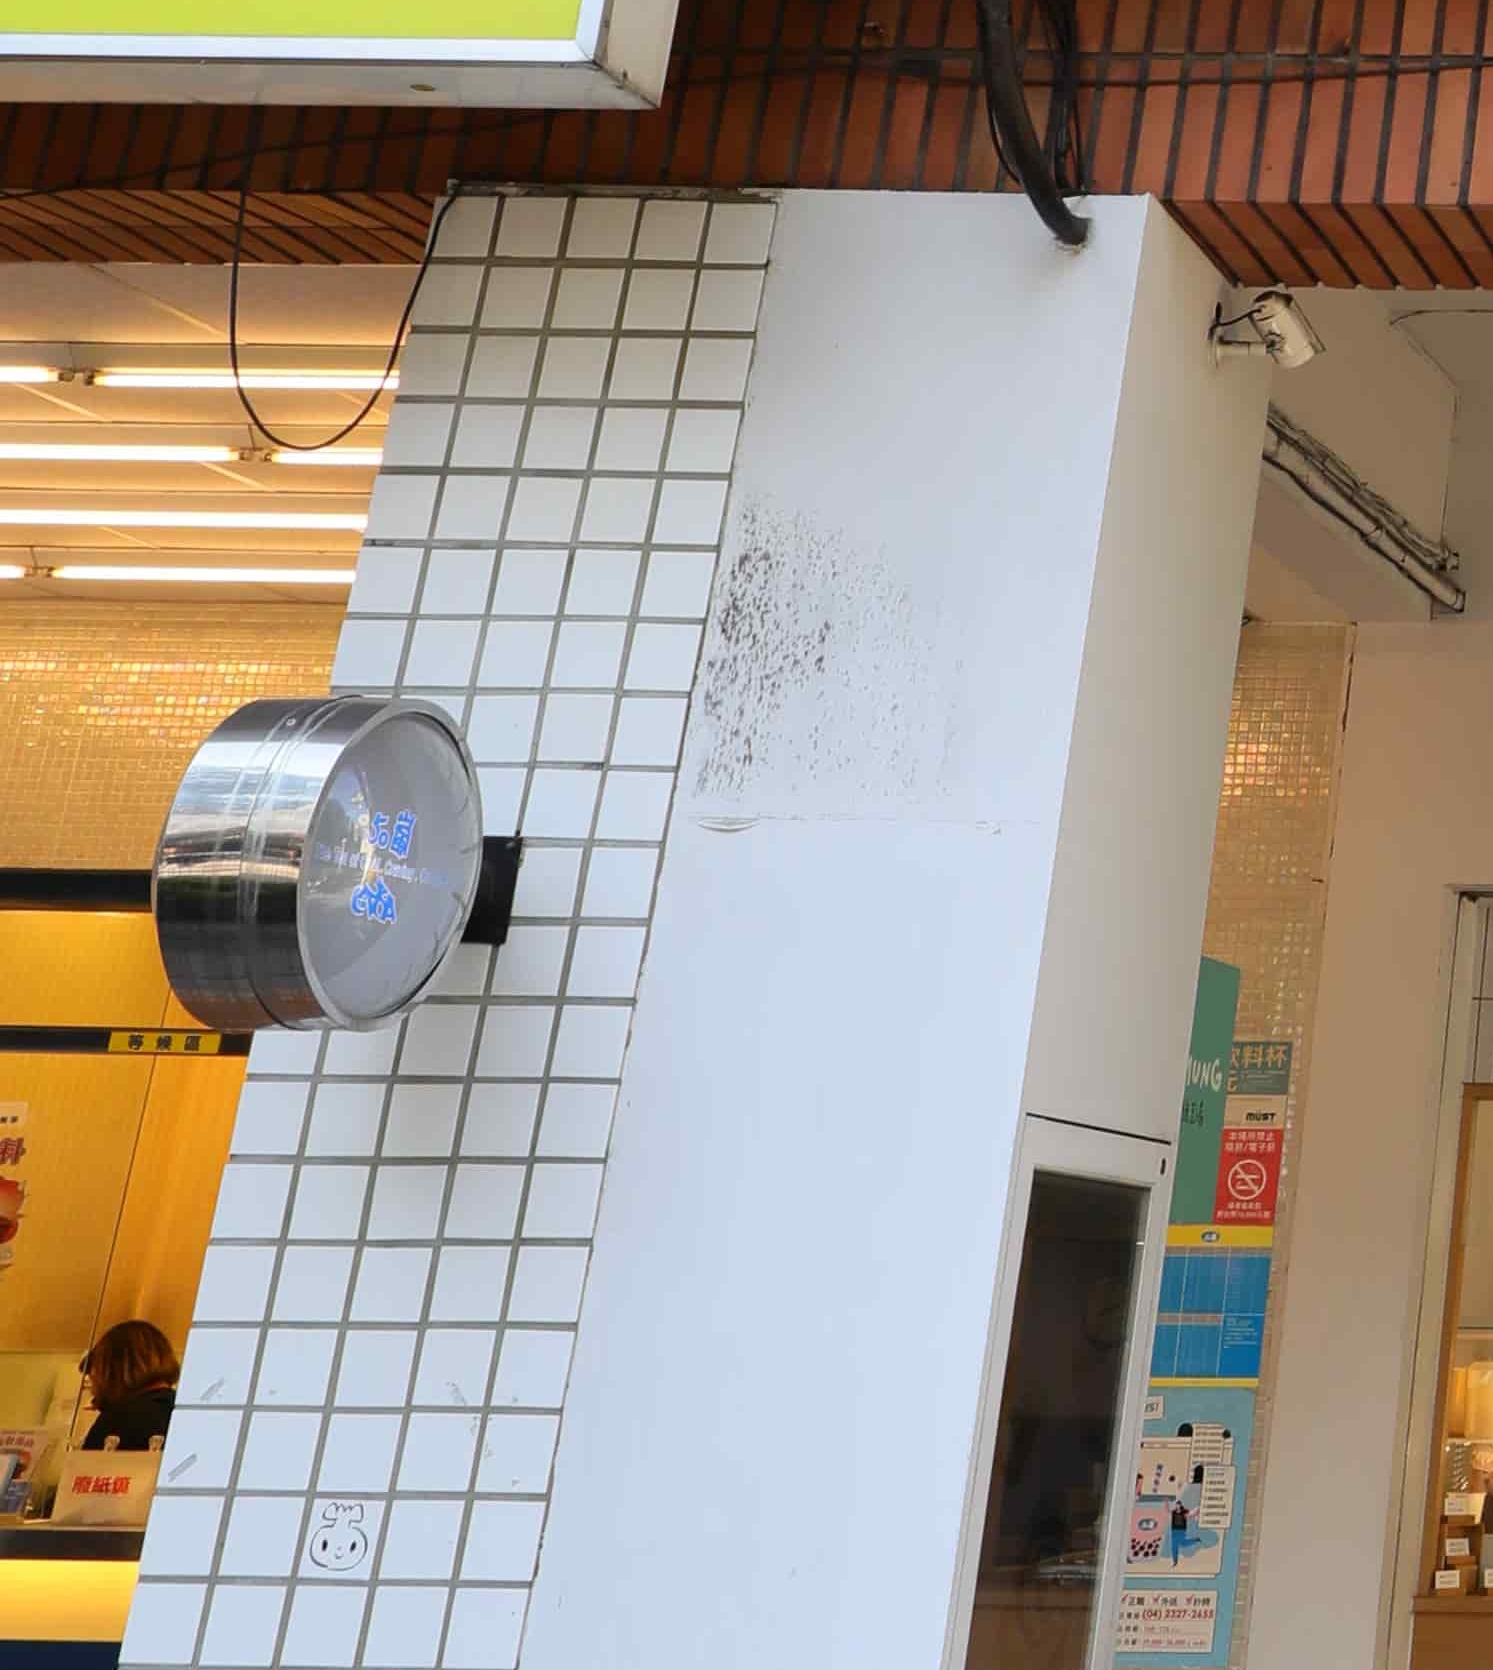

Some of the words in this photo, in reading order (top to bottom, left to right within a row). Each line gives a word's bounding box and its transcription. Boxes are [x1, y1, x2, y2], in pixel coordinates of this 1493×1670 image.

[127, 1034, 203, 1051] 等候區
[1186, 1057, 1223, 1093] UNG
